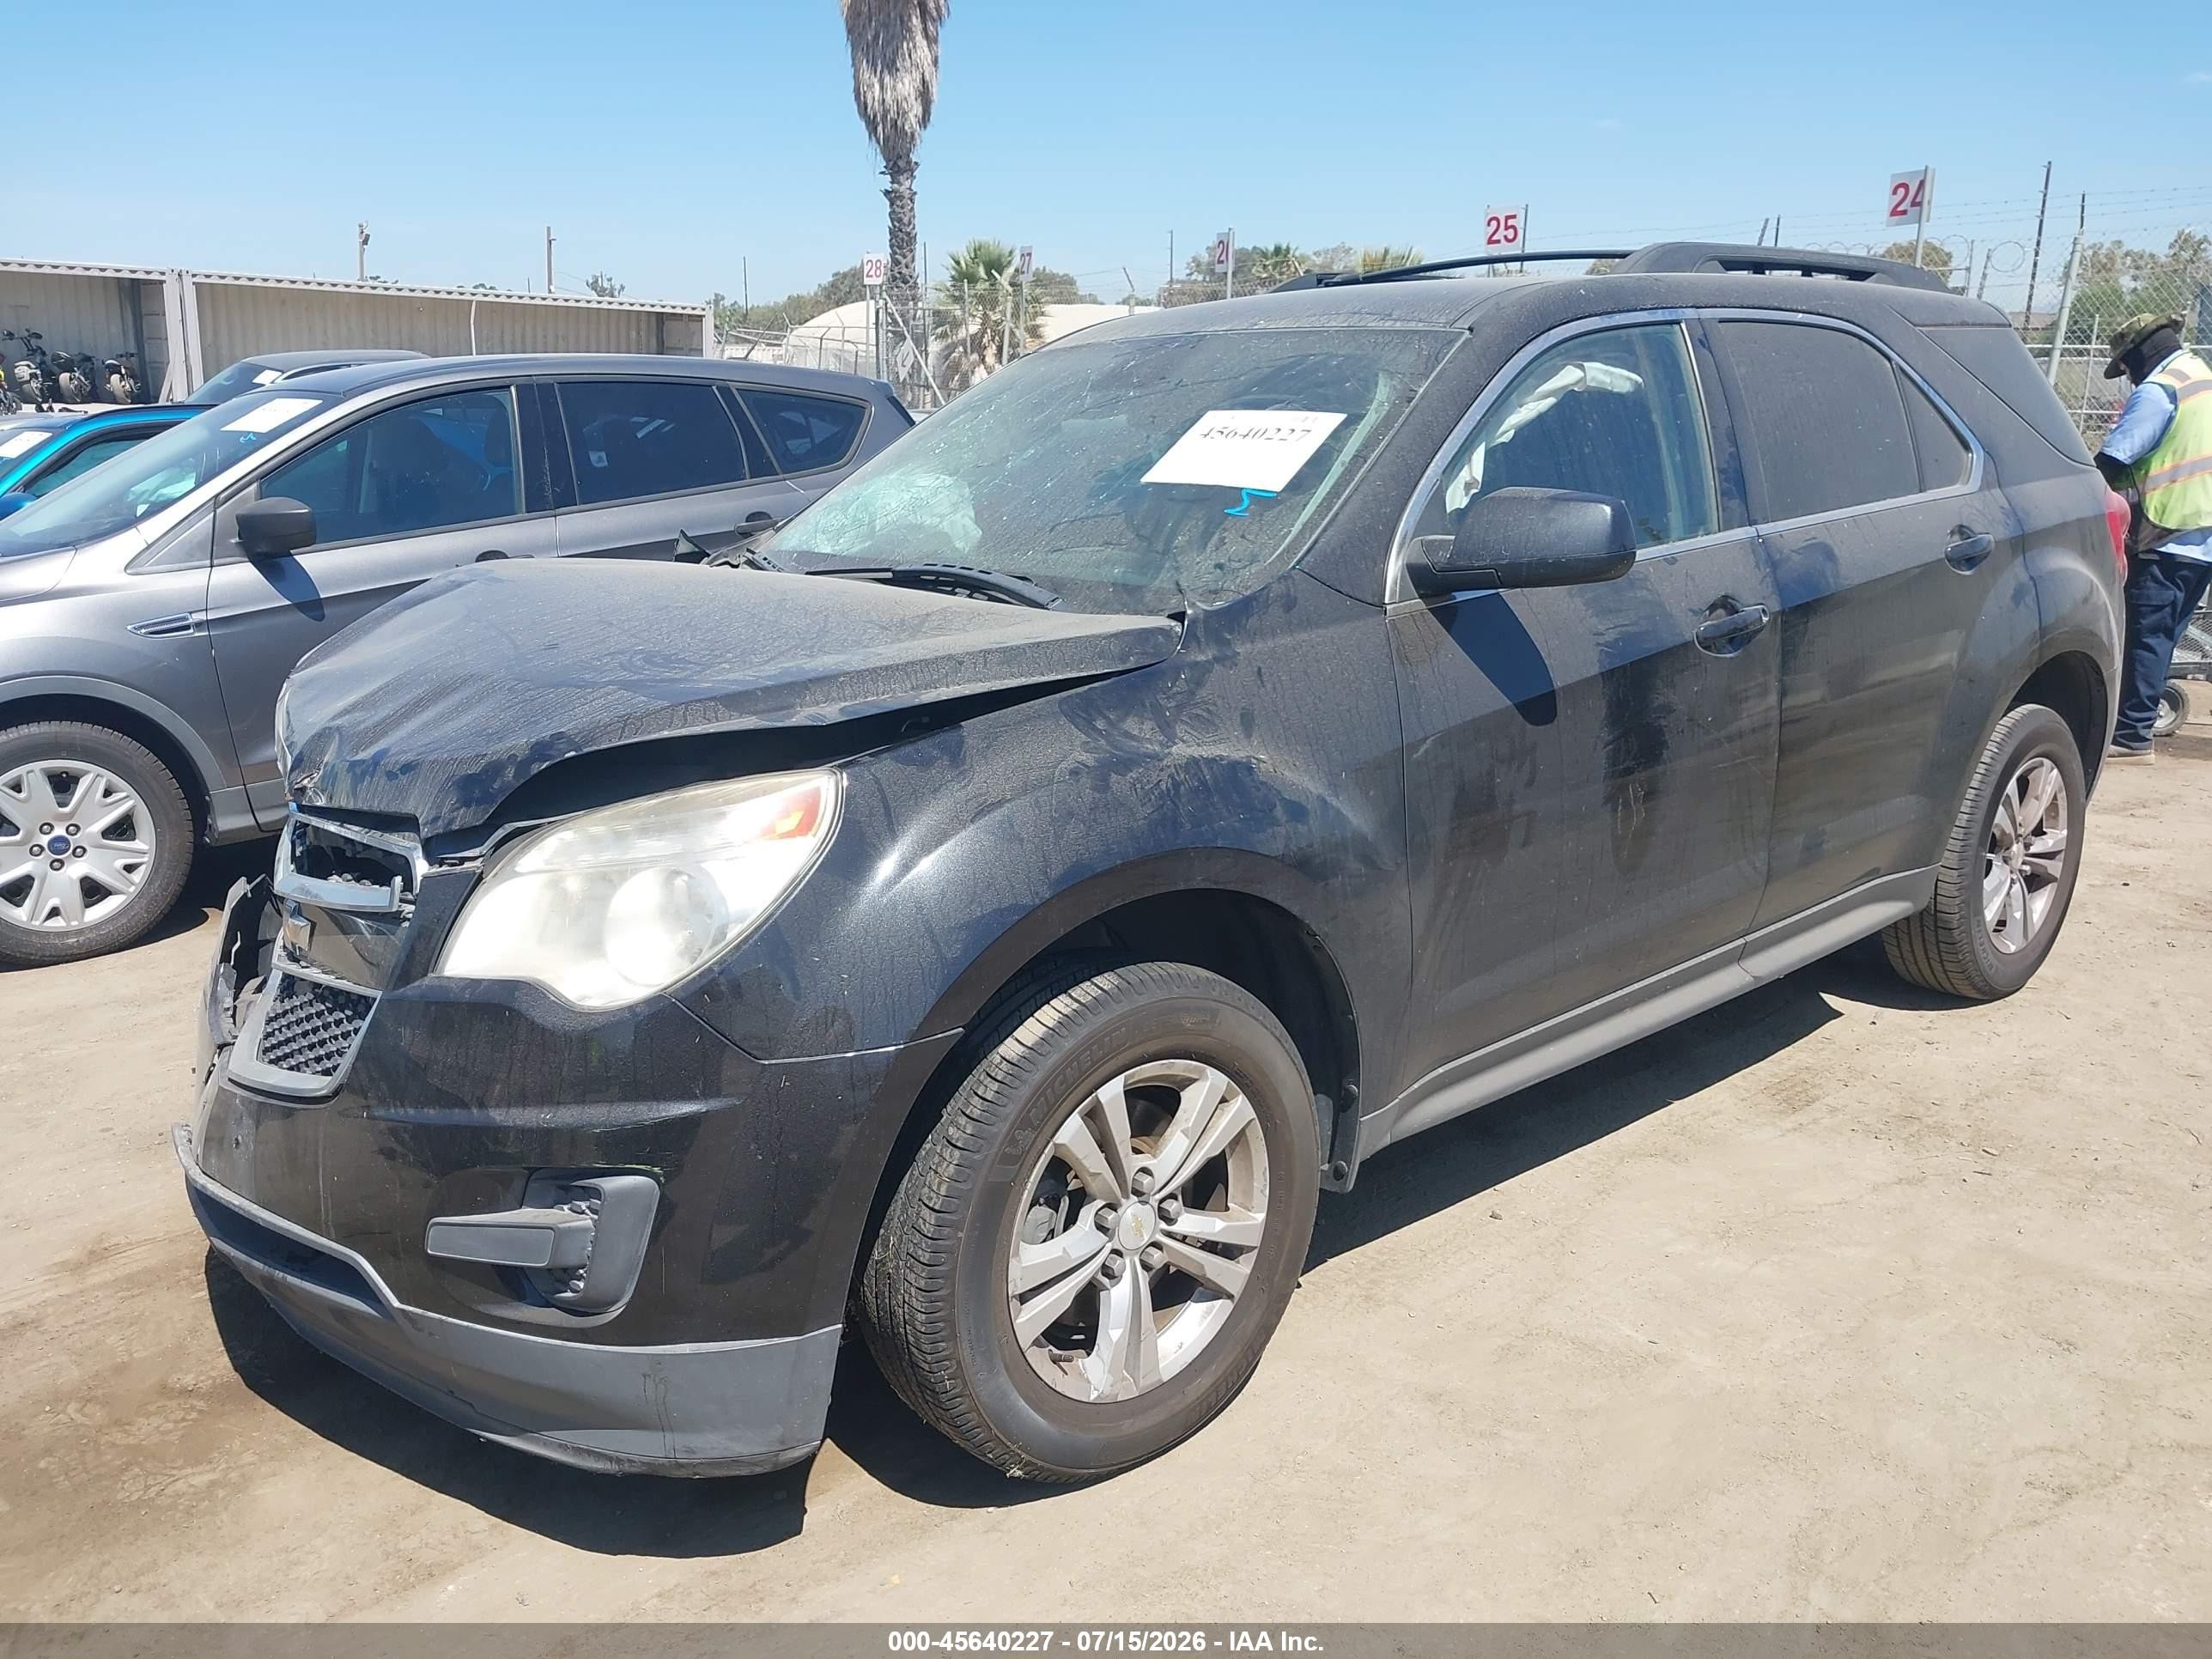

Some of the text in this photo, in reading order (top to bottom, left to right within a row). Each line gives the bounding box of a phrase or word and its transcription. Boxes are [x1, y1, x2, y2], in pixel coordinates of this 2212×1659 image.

[1486, 214, 1518, 246] 25
[1019, 252, 1032, 275] 27
[1217, 240, 1230, 264] 2
[865, 258, 883, 278] 28
[1199, 426, 1313, 442] 45640227
